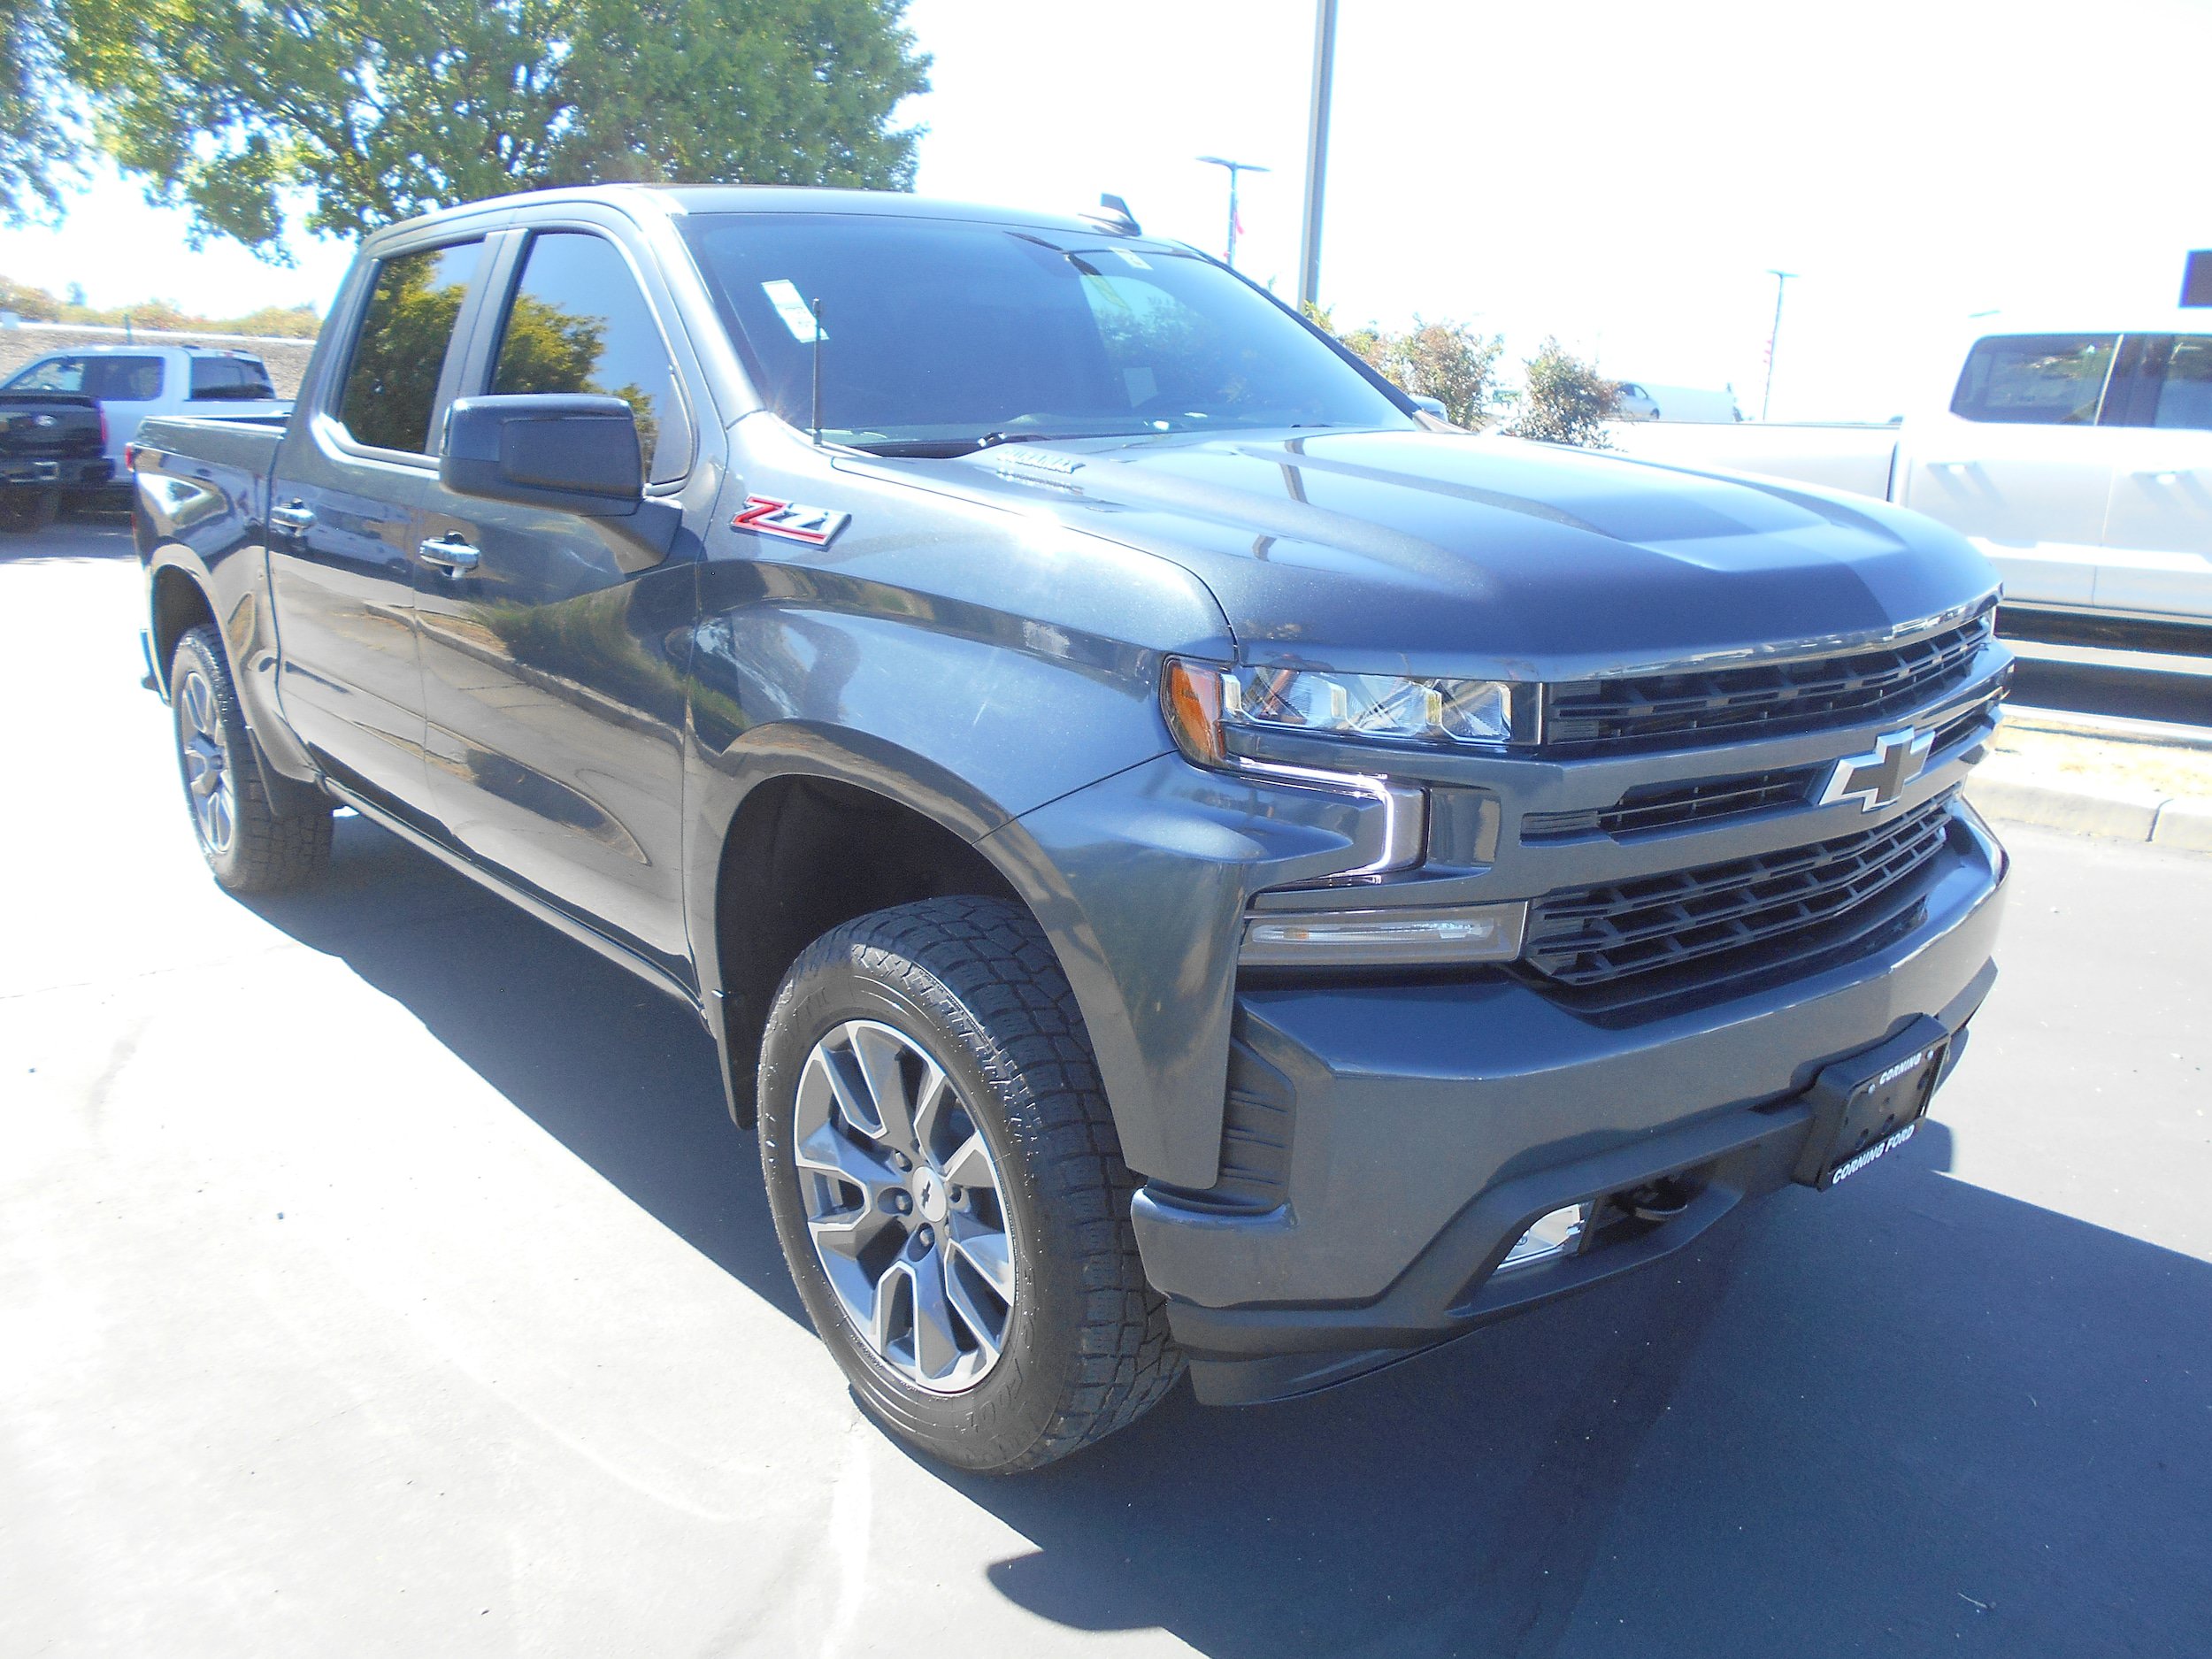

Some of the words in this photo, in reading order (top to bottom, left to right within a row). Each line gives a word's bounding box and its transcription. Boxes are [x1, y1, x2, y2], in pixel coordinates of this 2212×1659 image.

[731, 492, 852, 549] Z71
[1878, 1052, 1923, 1086] CORNING
[1832, 1141, 1886, 1185] CORNING
[1885, 1124, 1916, 1153] FORD
